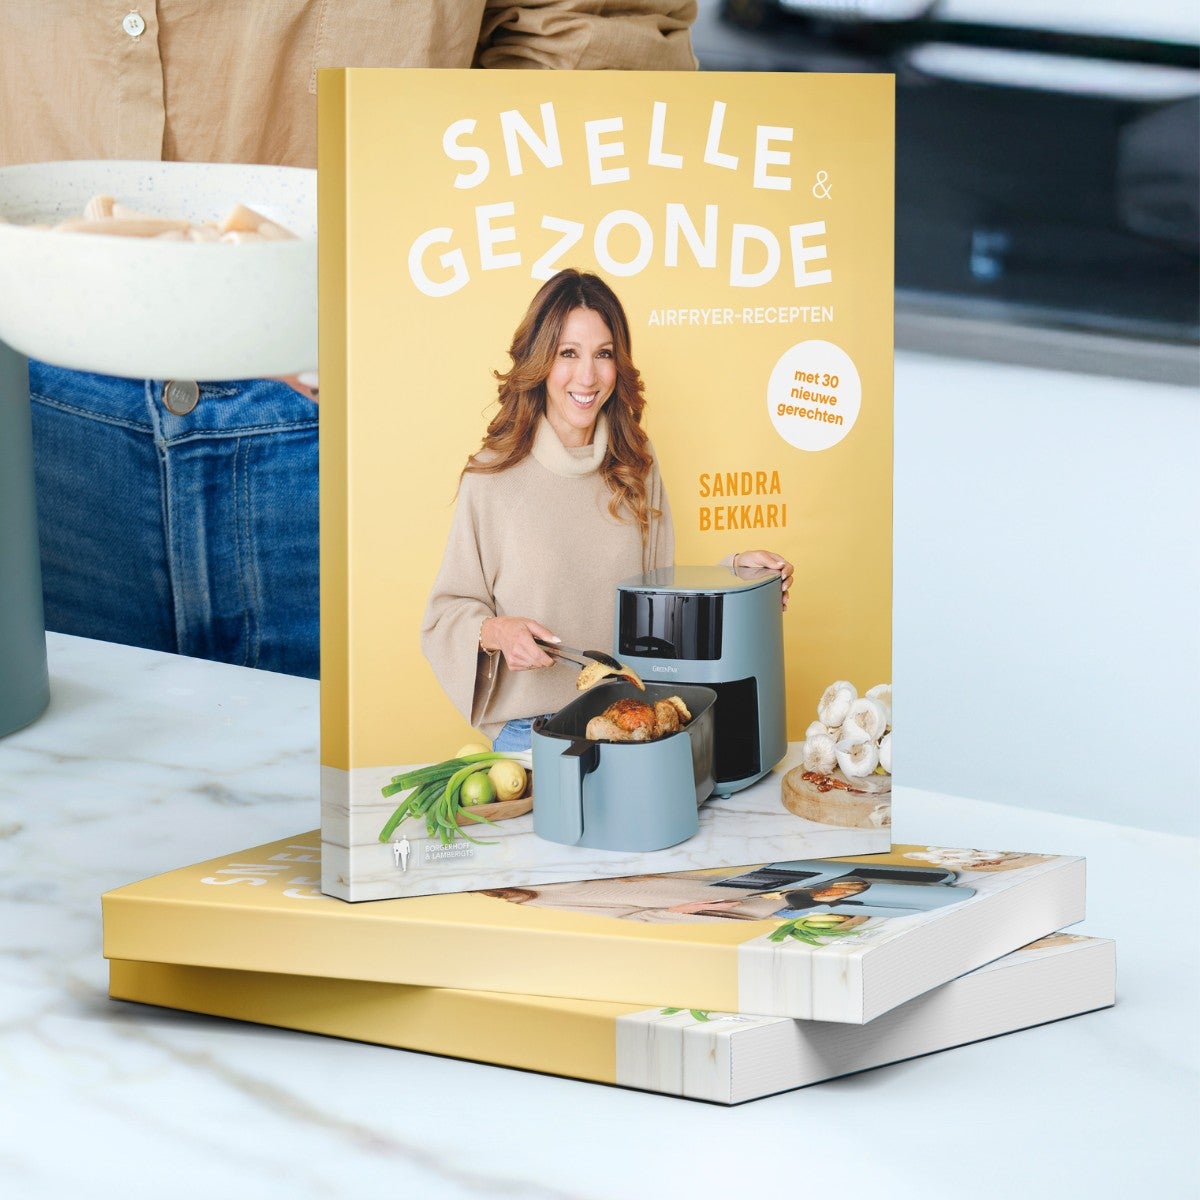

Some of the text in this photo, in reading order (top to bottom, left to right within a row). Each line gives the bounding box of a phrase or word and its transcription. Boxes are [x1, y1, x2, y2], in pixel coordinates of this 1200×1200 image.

[442, 101, 833, 199] SNELLE &
[407, 201, 833, 298] GEZONDE
[647, 305, 834, 327] AIRFRYER-RECEPTEN
[794, 370, 839, 389] met 30
[790, 386, 837, 406] nieuwe
[776, 402, 844, 426] gerechten
[699, 470, 782, 498] SANDRA
[699, 503, 787, 531] BEKKARI
